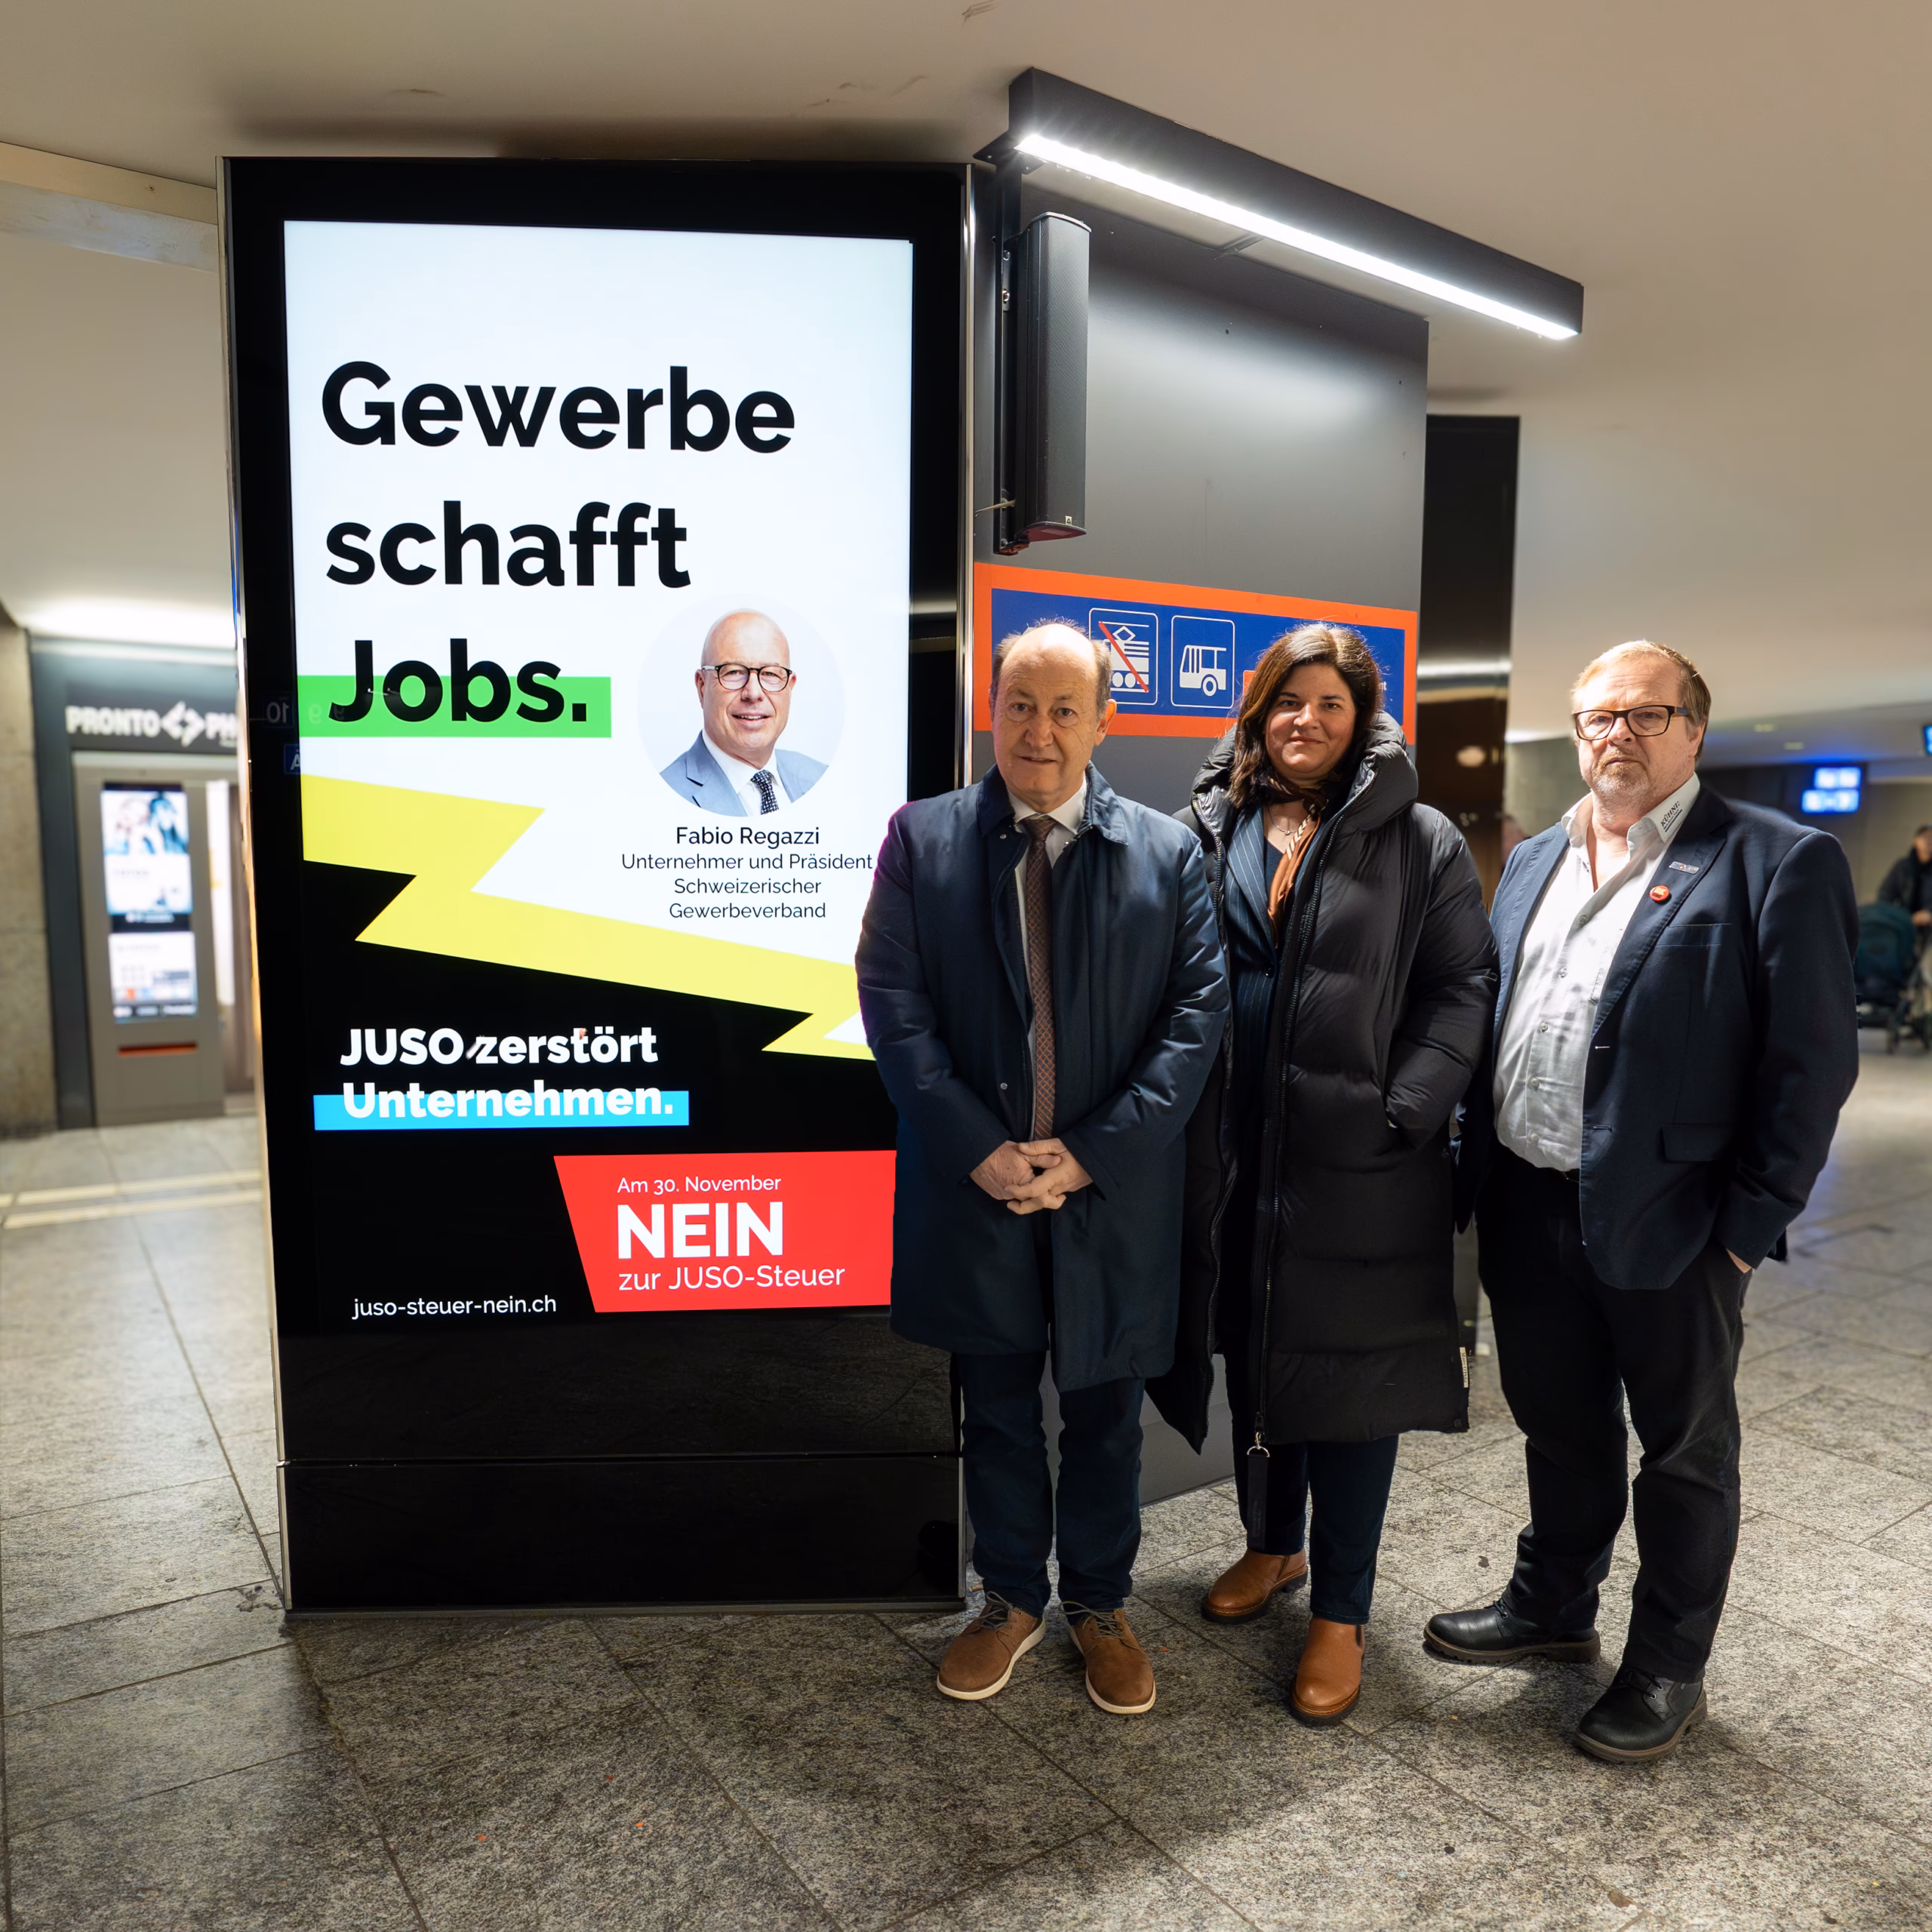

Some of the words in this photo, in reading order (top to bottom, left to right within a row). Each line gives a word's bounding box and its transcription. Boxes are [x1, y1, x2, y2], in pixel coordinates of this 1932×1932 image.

[322, 361, 795, 453] Gewerbe
[326, 500, 691, 589] schafft
[328, 638, 587, 722] Jobs.
[66, 706, 161, 737] PRONTO
[205, 712, 238, 740] PH
[676, 826, 733, 844] Fabio
[740, 826, 819, 850] Regazzi
[622, 854, 743, 869] Unternehmer
[749, 854, 783, 869] und
[789, 854, 872, 869] Präsident
[675, 878, 822, 894] Schweizerischer
[669, 903, 826, 918] Gewerbeverband
[340, 1027, 463, 1066] JUSO
[475, 1026, 659, 1064] zerstört
[343, 1079, 673, 1118] Unternehmen.
[617, 1177, 648, 1193] Am
[653, 1178, 680, 1195] 30.
[685, 1174, 782, 1192] November
[617, 1201, 783, 1260] NEIN
[618, 1272, 662, 1291] zur
[668, 1264, 846, 1290] JUSO-Steuer
[352, 1294, 556, 1320] juso-steuer-nein.ch
